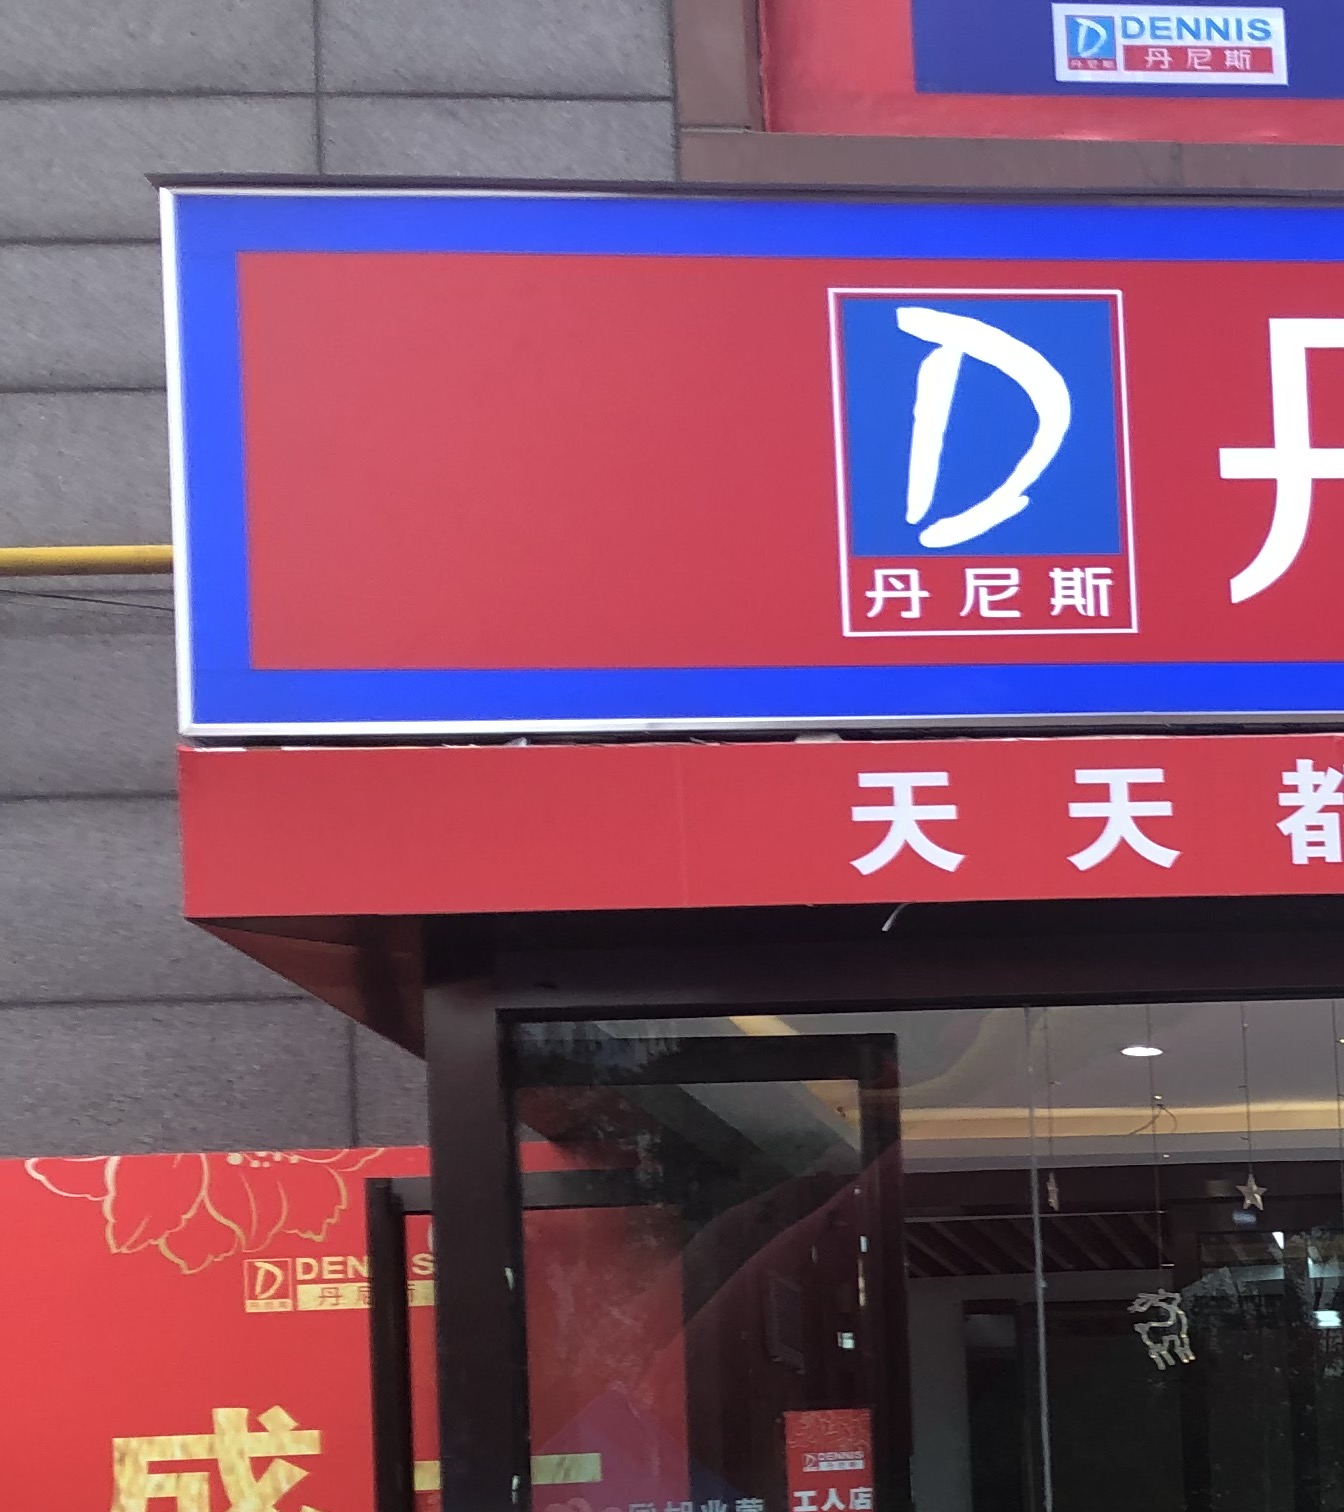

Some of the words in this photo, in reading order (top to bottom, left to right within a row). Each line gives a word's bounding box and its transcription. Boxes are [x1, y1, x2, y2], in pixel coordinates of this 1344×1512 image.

[1121, 15, 1272, 42] DENNIS
[1144, 48, 1252, 70] 丹尼斯
[865, 567, 1115, 619] 丹尼斯
[793, 1486, 873, 1512] 工人店
